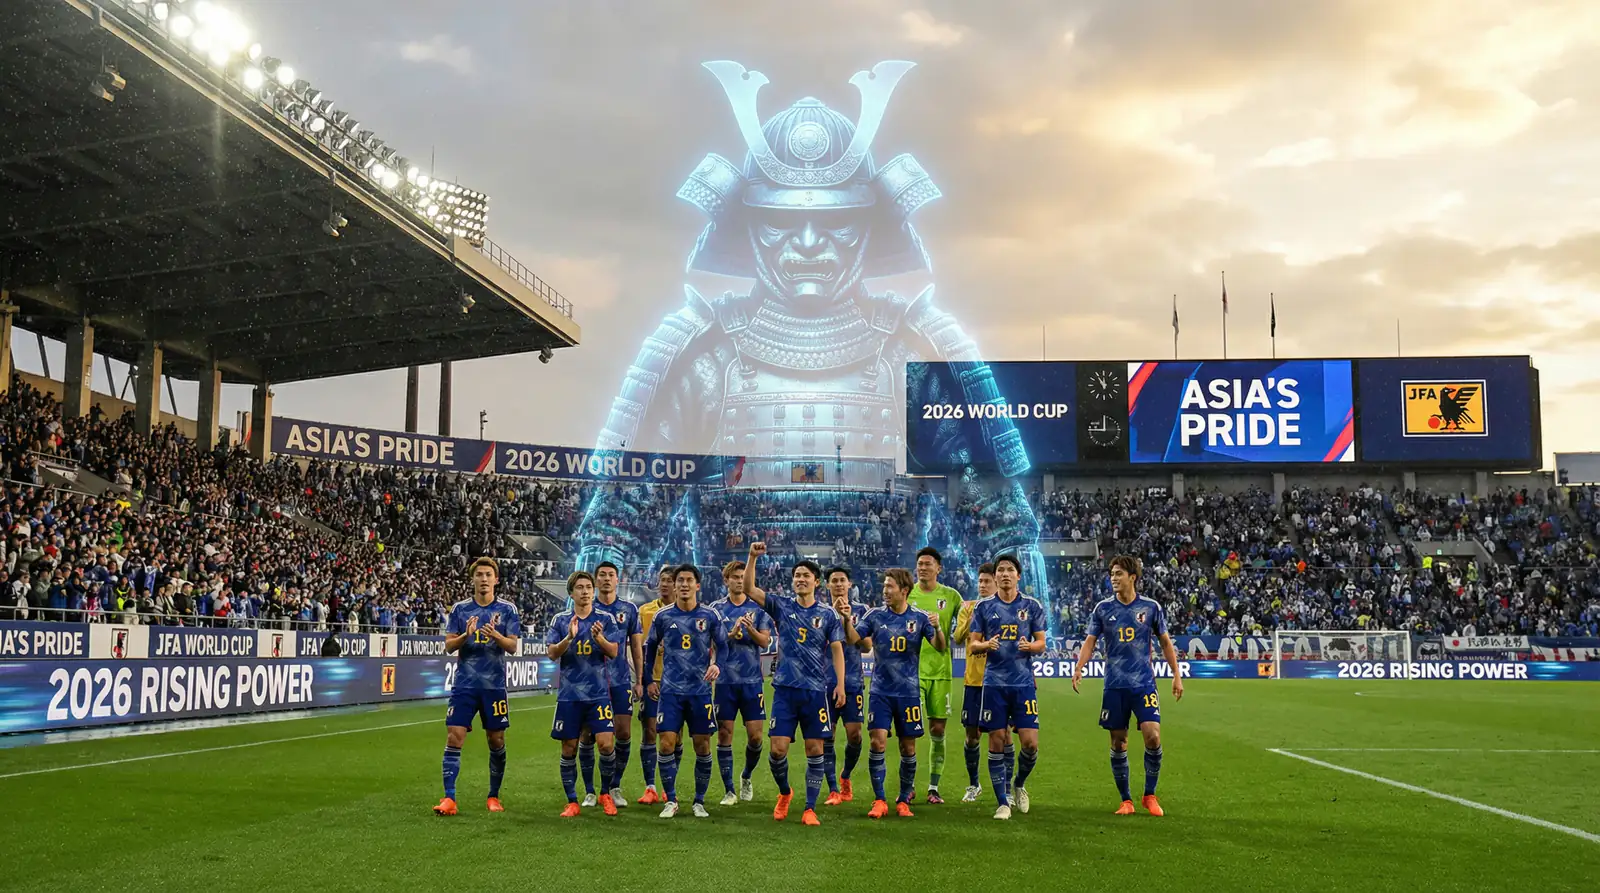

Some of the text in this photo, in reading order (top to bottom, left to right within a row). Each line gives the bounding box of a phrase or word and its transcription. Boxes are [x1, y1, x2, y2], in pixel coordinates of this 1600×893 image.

[1180, 377, 1300, 409] ASIA'S
[1408, 388, 1437, 400] JFA
[922, 403, 1068, 419] 2026 WORLD CUP
[1180, 413, 1301, 447] PRIDE
[285, 424, 454, 465] ASIA'S PRIDE
[505, 448, 696, 480] 2026 WORLD CUP
[33, 630, 83, 655] PRIDE
[681, 634, 691, 650] 8
[1118, 627, 1135, 642] 19
[155, 633, 253, 656] JFA WORLD CUP
[300, 637, 318, 655] JFA
[351, 638, 367, 655] CUP
[400, 640, 412, 655] JFA
[576, 639, 592, 655] 16
[889, 635, 907, 652] 10
[506, 661, 538, 687] POWER
[1032, 661, 1054, 676] 26
[1337, 662, 1528, 679] 2026 RISING POWER
[46, 664, 314, 720] 2026 RISING POWER
[1143, 693, 1159, 708] 18
[856, 695, 863, 710] 9
[597, 704, 613, 720] 16
[704, 703, 713, 720] 7
[818, 707, 828, 723] 6
[905, 705, 921, 723] 10
